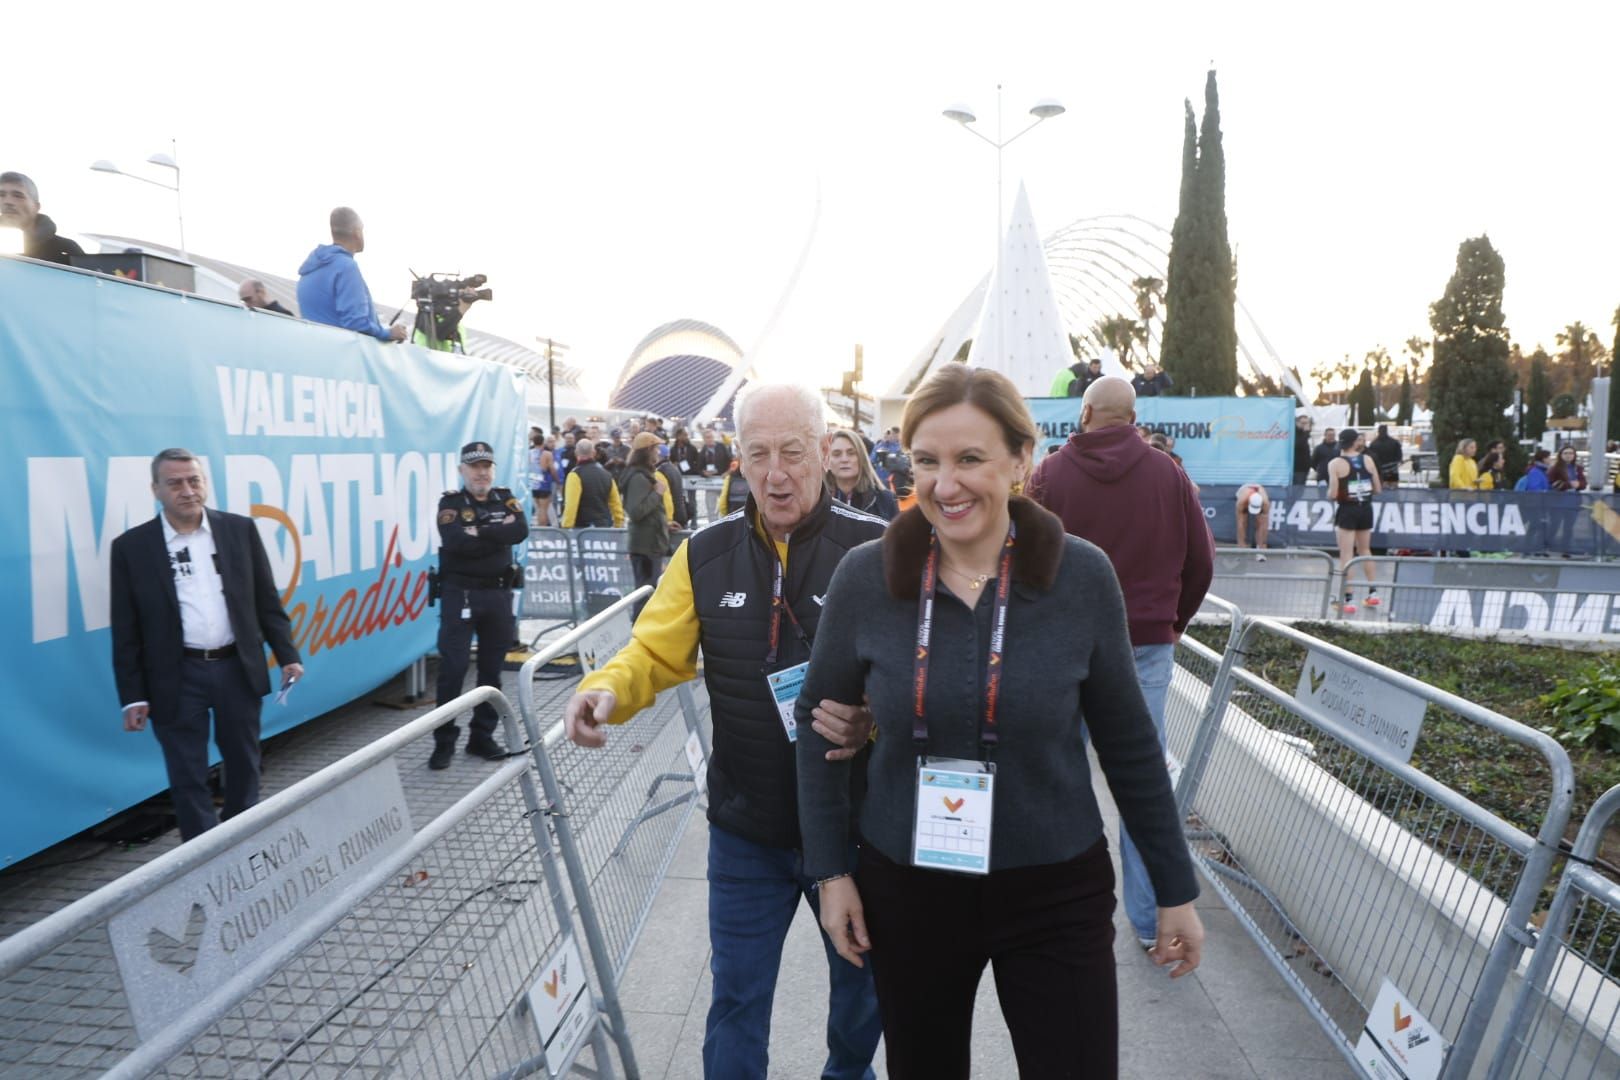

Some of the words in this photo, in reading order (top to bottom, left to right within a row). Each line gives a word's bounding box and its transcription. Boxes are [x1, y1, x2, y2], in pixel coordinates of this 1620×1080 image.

[216, 365, 385, 438] VALENCIA
[27, 450, 459, 644] MRATHON
[1268, 498, 1526, 536] #42ALENCIA
[207, 828, 309, 907] VALENCIA
[220, 879, 299, 953] CIUDAD
[301, 856, 339, 898] DEL
[338, 806, 402, 871] RUNNING
